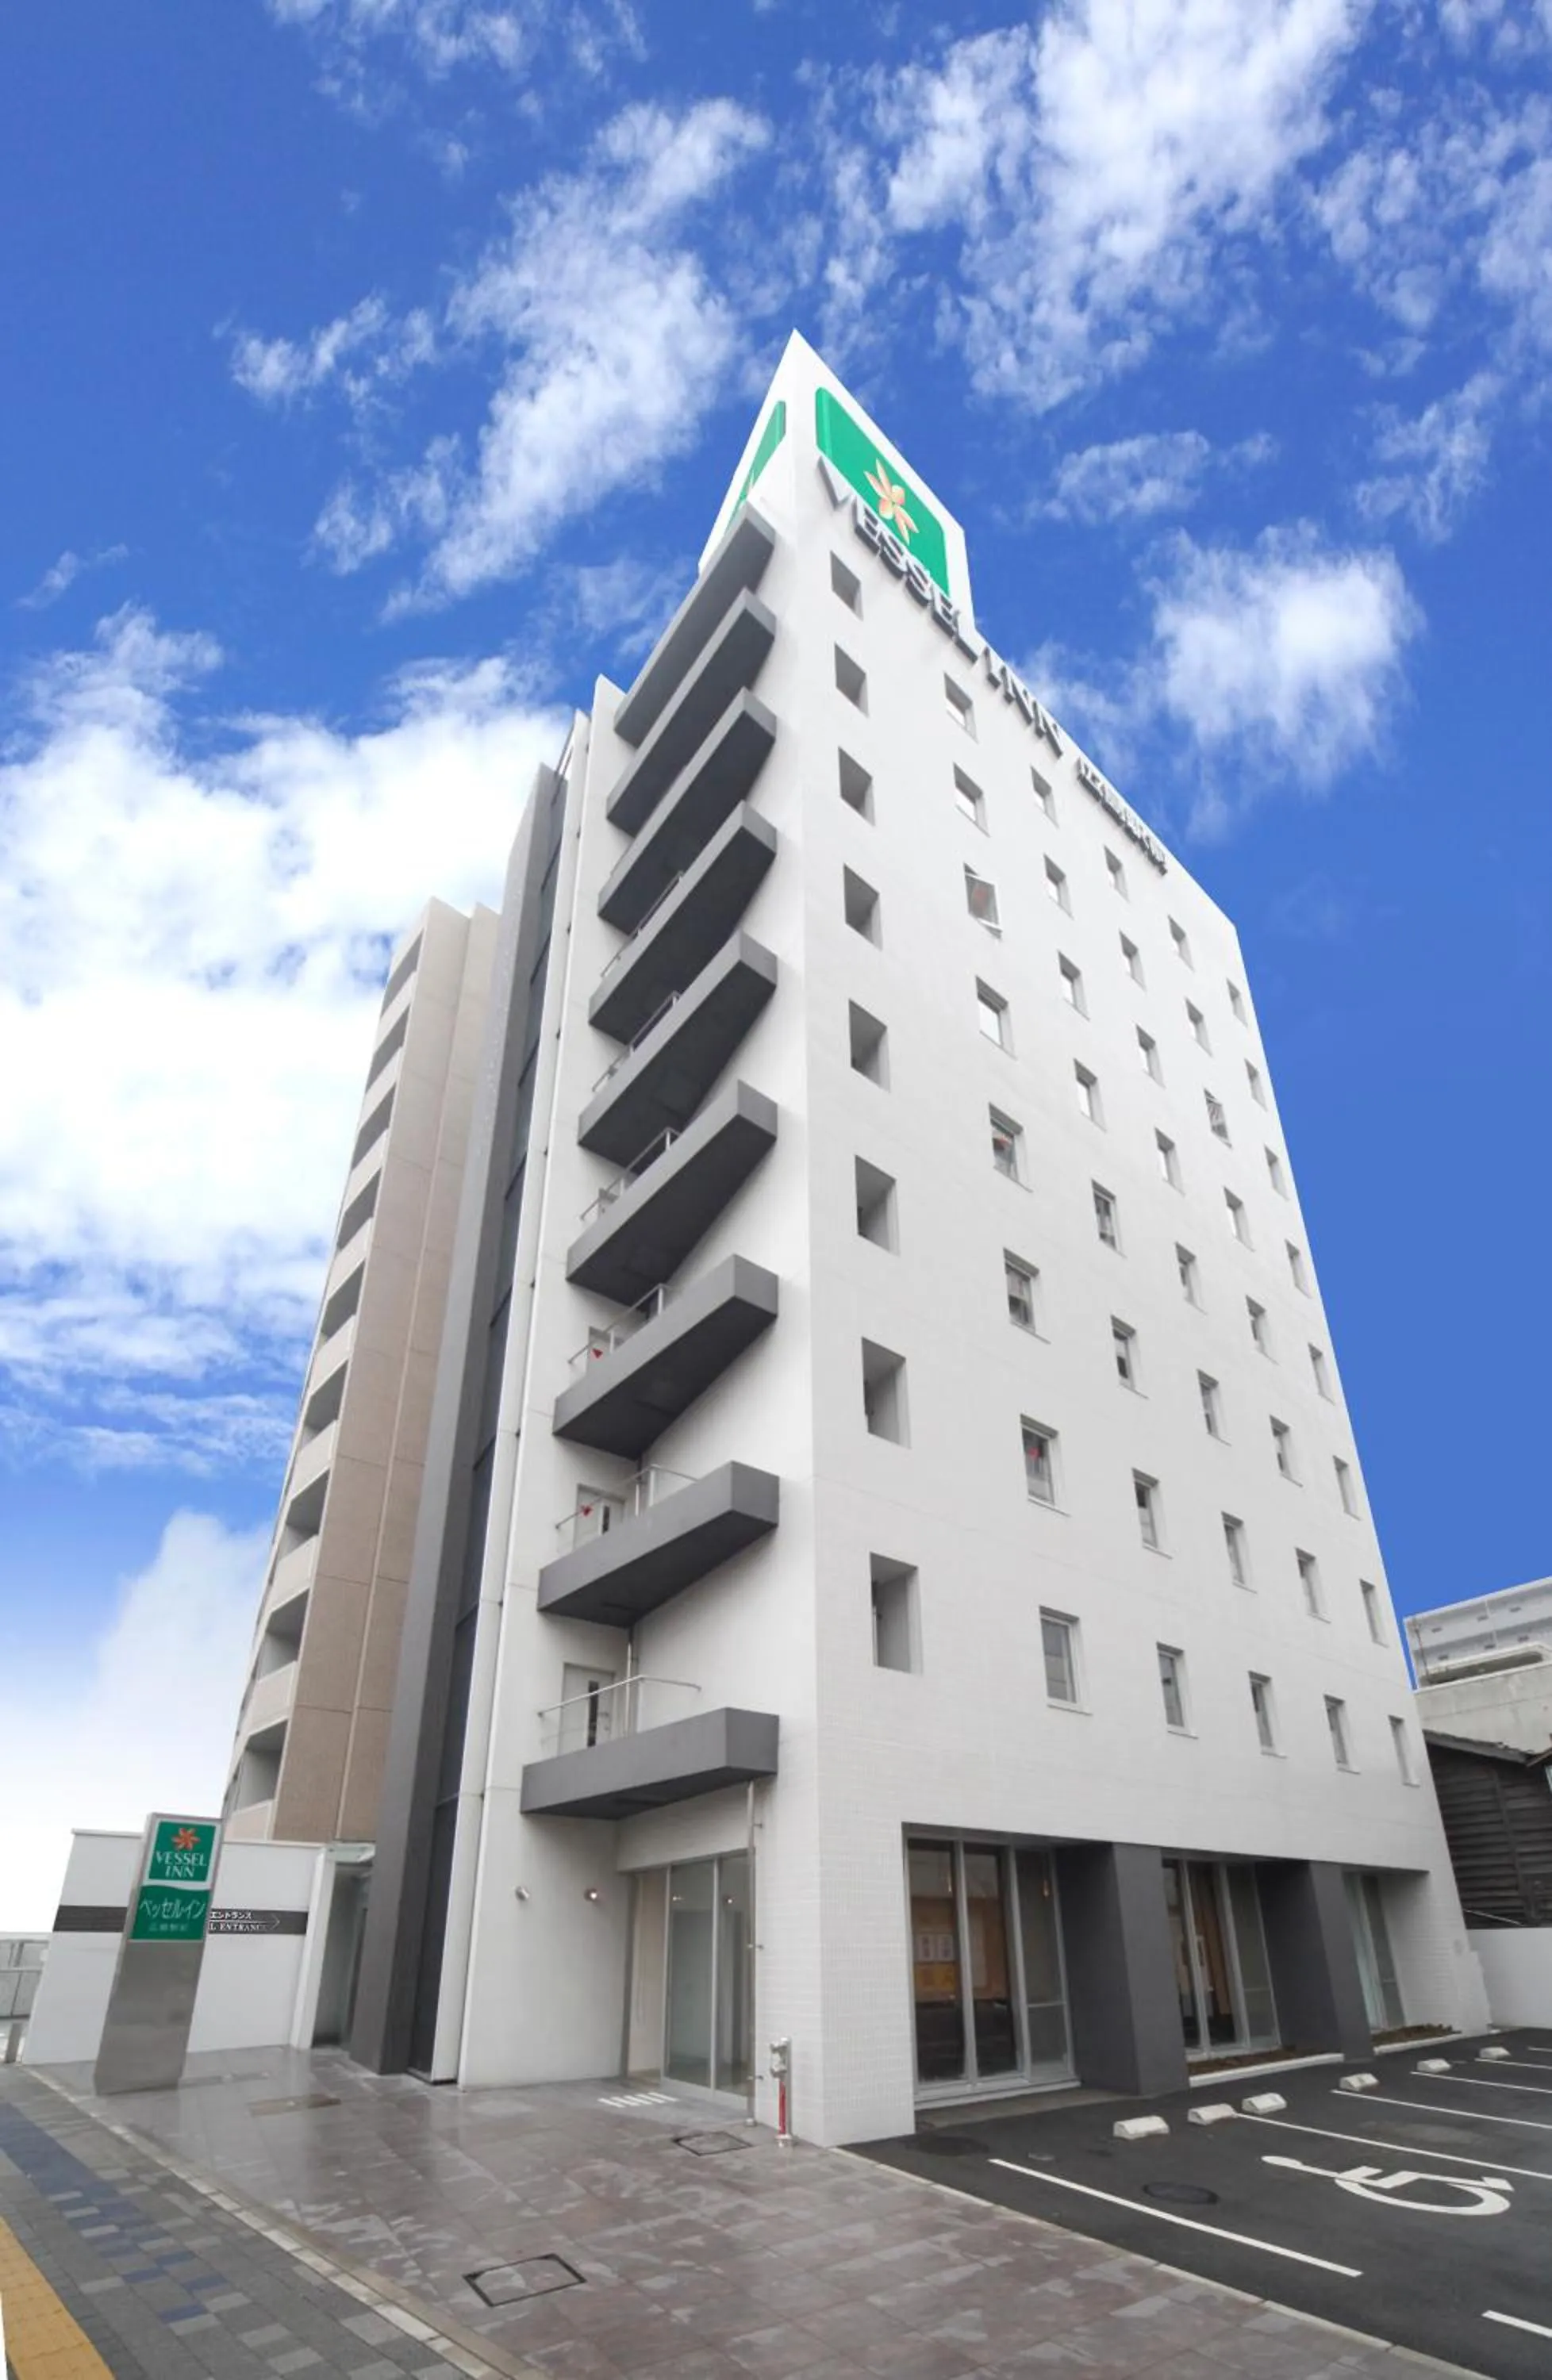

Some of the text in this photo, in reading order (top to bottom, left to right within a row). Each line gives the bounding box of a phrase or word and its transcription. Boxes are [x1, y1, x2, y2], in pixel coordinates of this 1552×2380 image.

[816, 454, 1064, 758] VESSEL INN
[155, 1851, 208, 1867] VESSEL
[164, 1865, 195, 1878] INN
[139, 1897, 206, 1919] ベッセルイン
